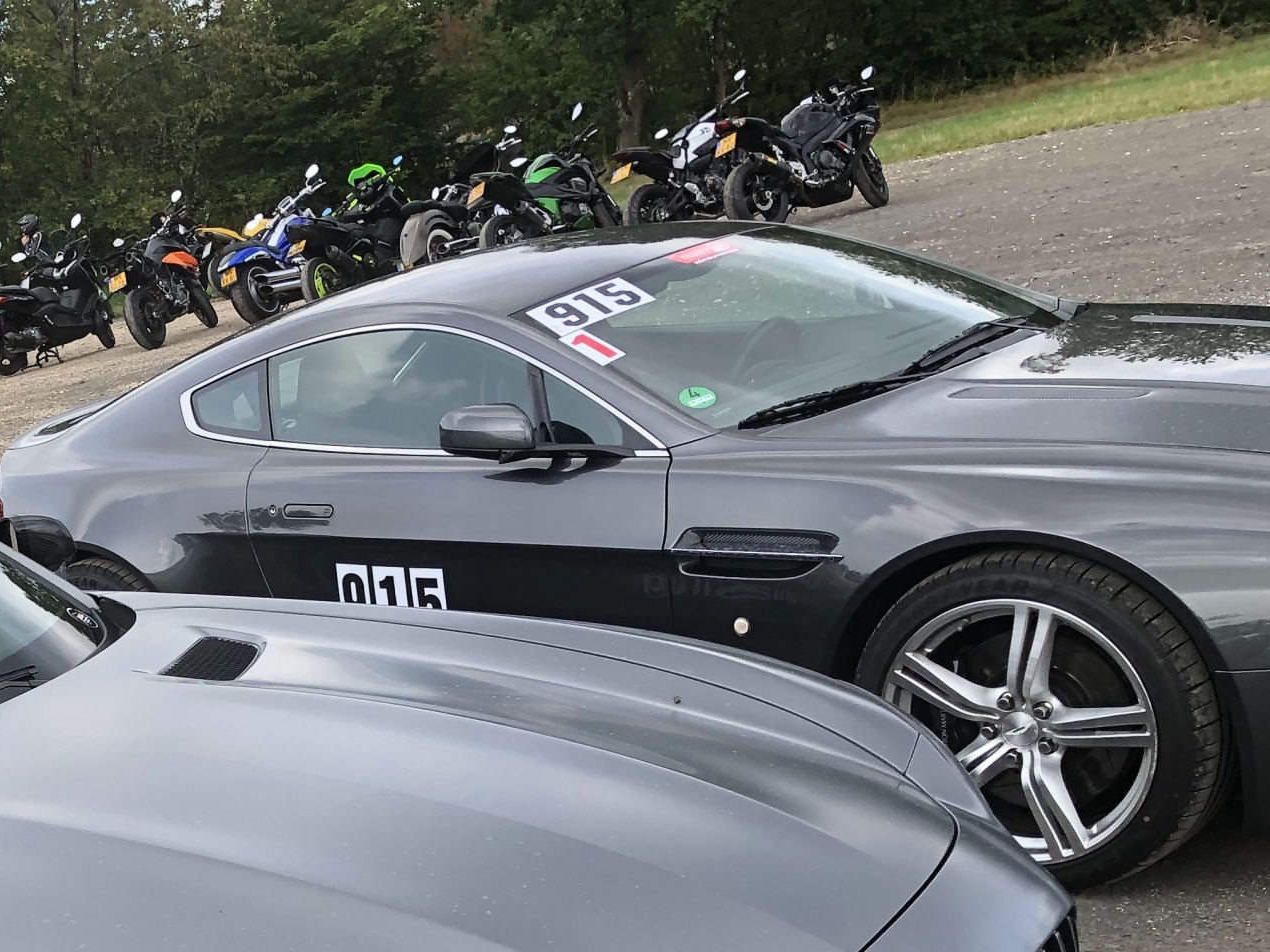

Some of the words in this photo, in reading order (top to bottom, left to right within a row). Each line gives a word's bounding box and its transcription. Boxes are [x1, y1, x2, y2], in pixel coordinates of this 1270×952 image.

[544, 282, 642, 327] 915
[571, 333, 618, 358] 1
[688, 388, 700, 399] 4
